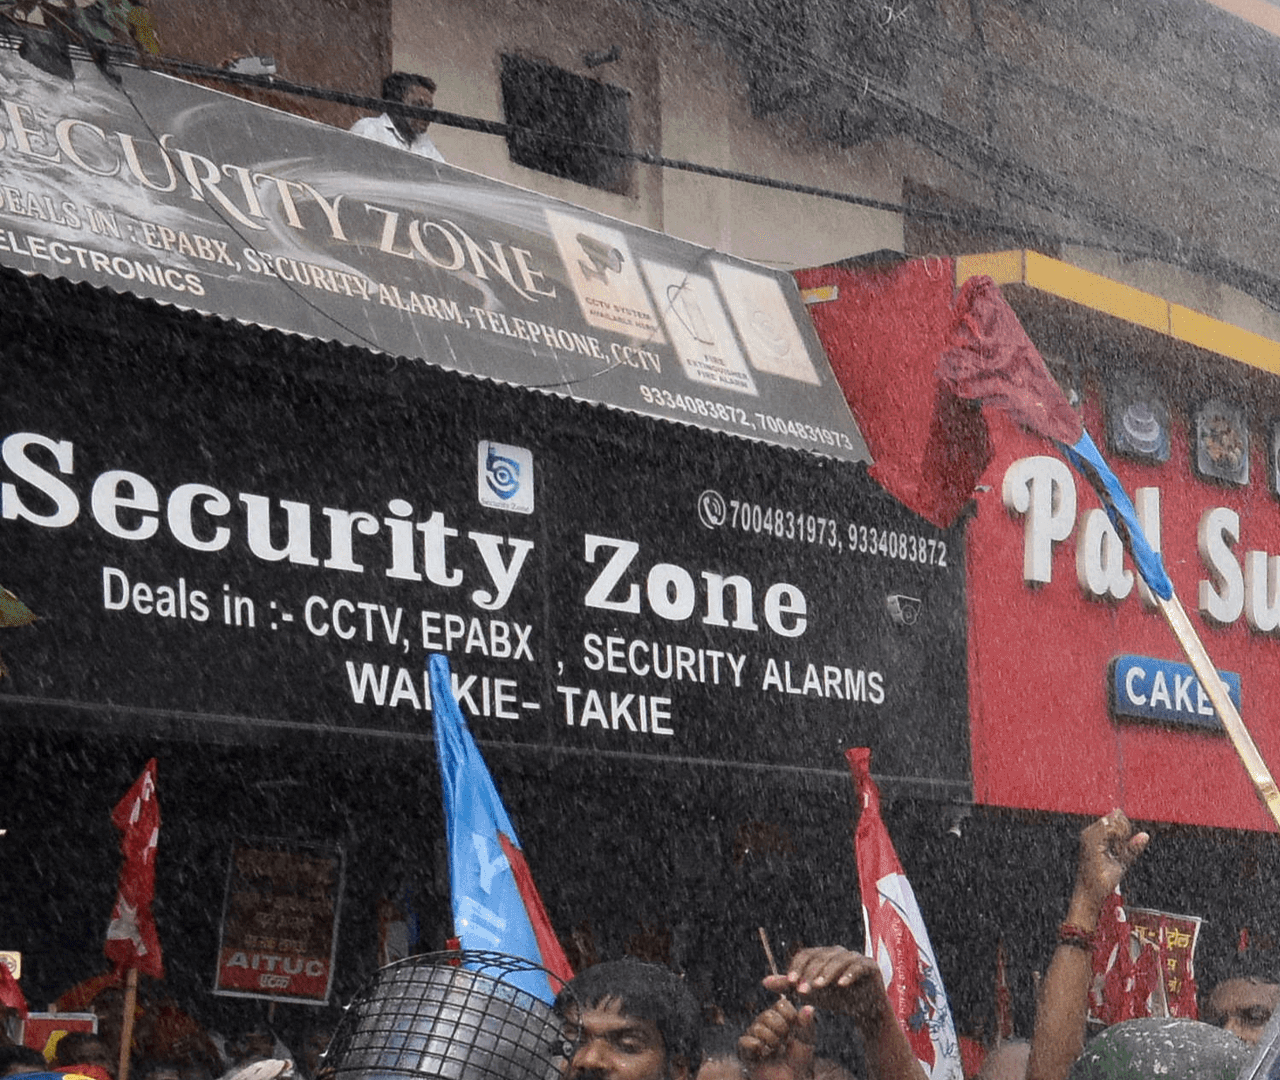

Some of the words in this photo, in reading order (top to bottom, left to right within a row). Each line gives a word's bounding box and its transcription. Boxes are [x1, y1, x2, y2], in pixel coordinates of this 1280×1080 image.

[0, 99, 347, 242] ECURITY
[363, 202, 557, 302] ZONE
[0, 184, 80, 228] EALS
[84, 205, 122, 239] IN
[242, 247, 371, 301] SECURITY
[378, 283, 470, 329] ALARM,
[469, 304, 609, 364] TELEPHONE,
[609, 341, 662, 373] CCTV
[755, 412, 853, 450] 7004831973
[1, 431, 534, 611] Security
[585, 533, 808, 638] Zone
[730, 500, 842, 555] 7004831973,
[848, 529, 947, 568] 9334083872
[102, 566, 211, 622] Deals
[222, 584, 256, 628] in
[421, 611, 536, 662] EPABX
[583, 633, 746, 688] SECURITY
[762, 658, 886, 704] ALARMS
[556, 686, 675, 735] TAKIE
[226, 951, 324, 977] AITUC
